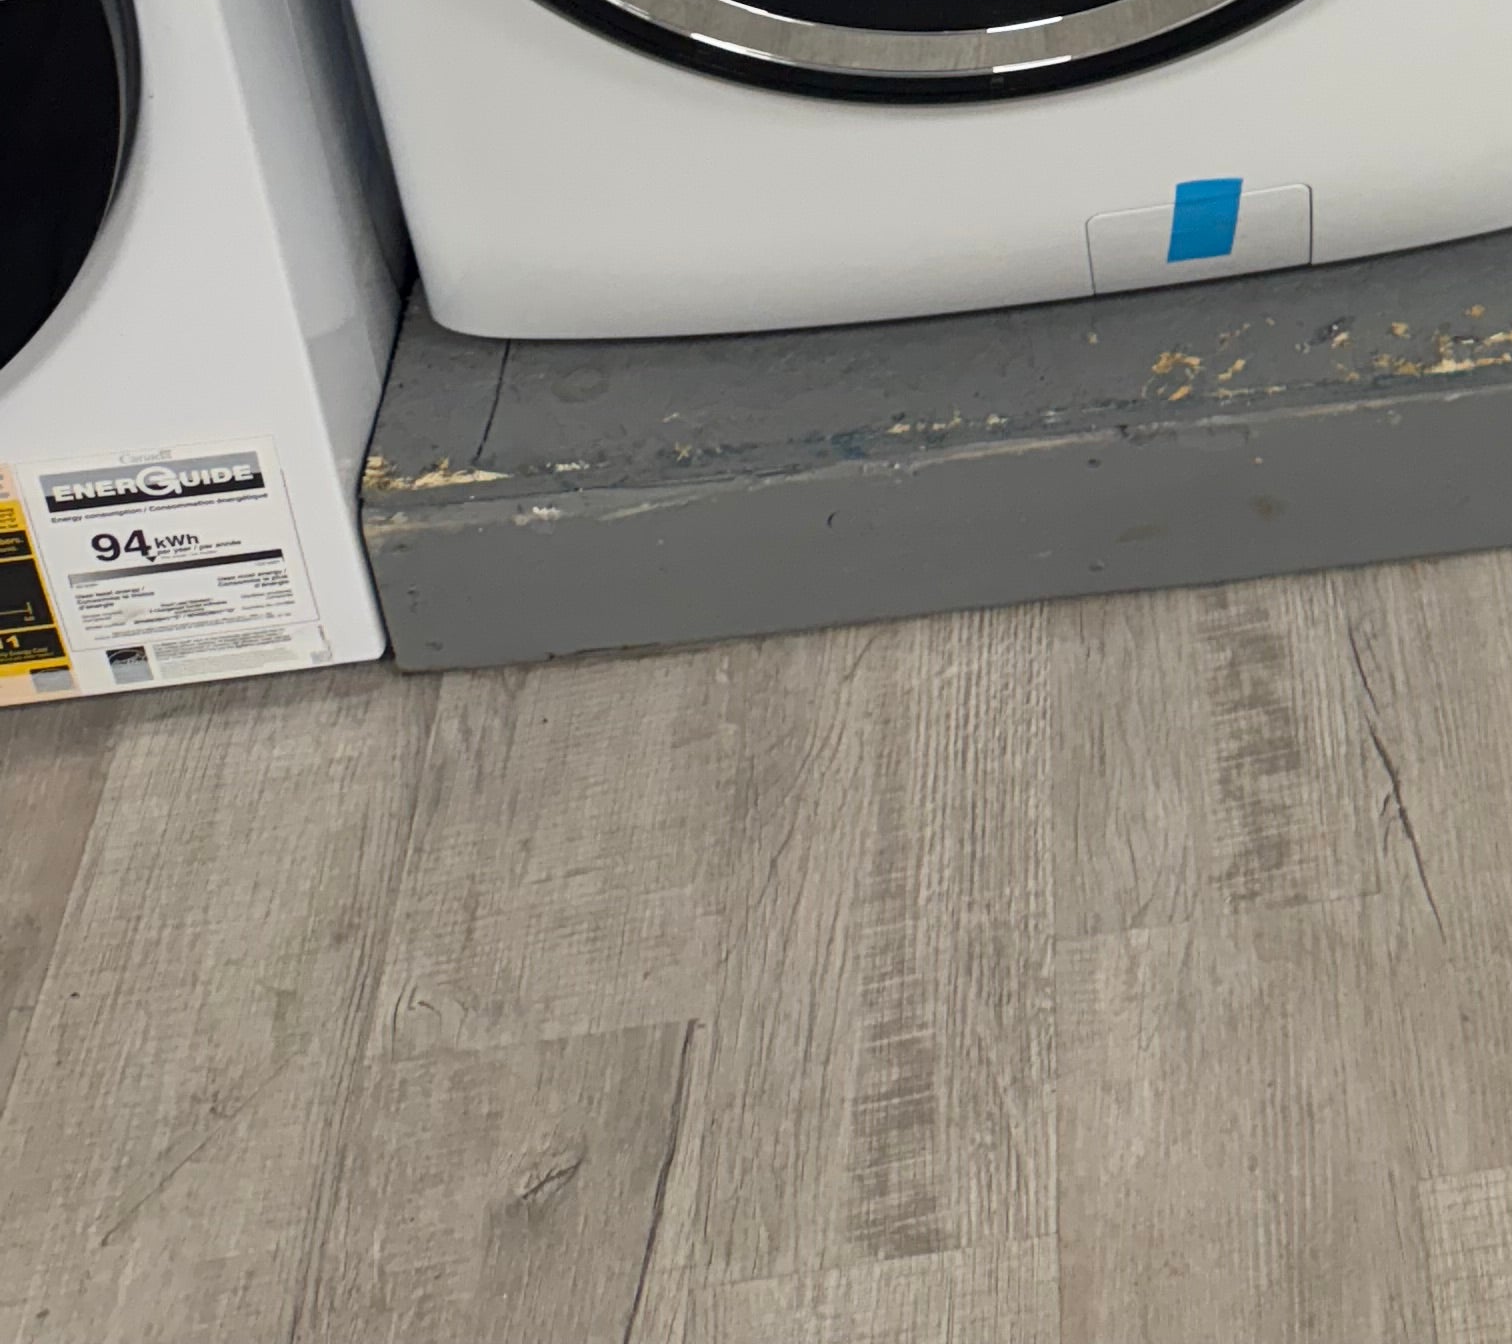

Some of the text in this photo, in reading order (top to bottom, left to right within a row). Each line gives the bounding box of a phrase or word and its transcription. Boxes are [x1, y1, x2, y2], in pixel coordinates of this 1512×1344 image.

[52, 465, 254, 503] ENERGUIDE
[51, 514, 83, 524] Energy
[91, 529, 200, 563] 94 kWh
